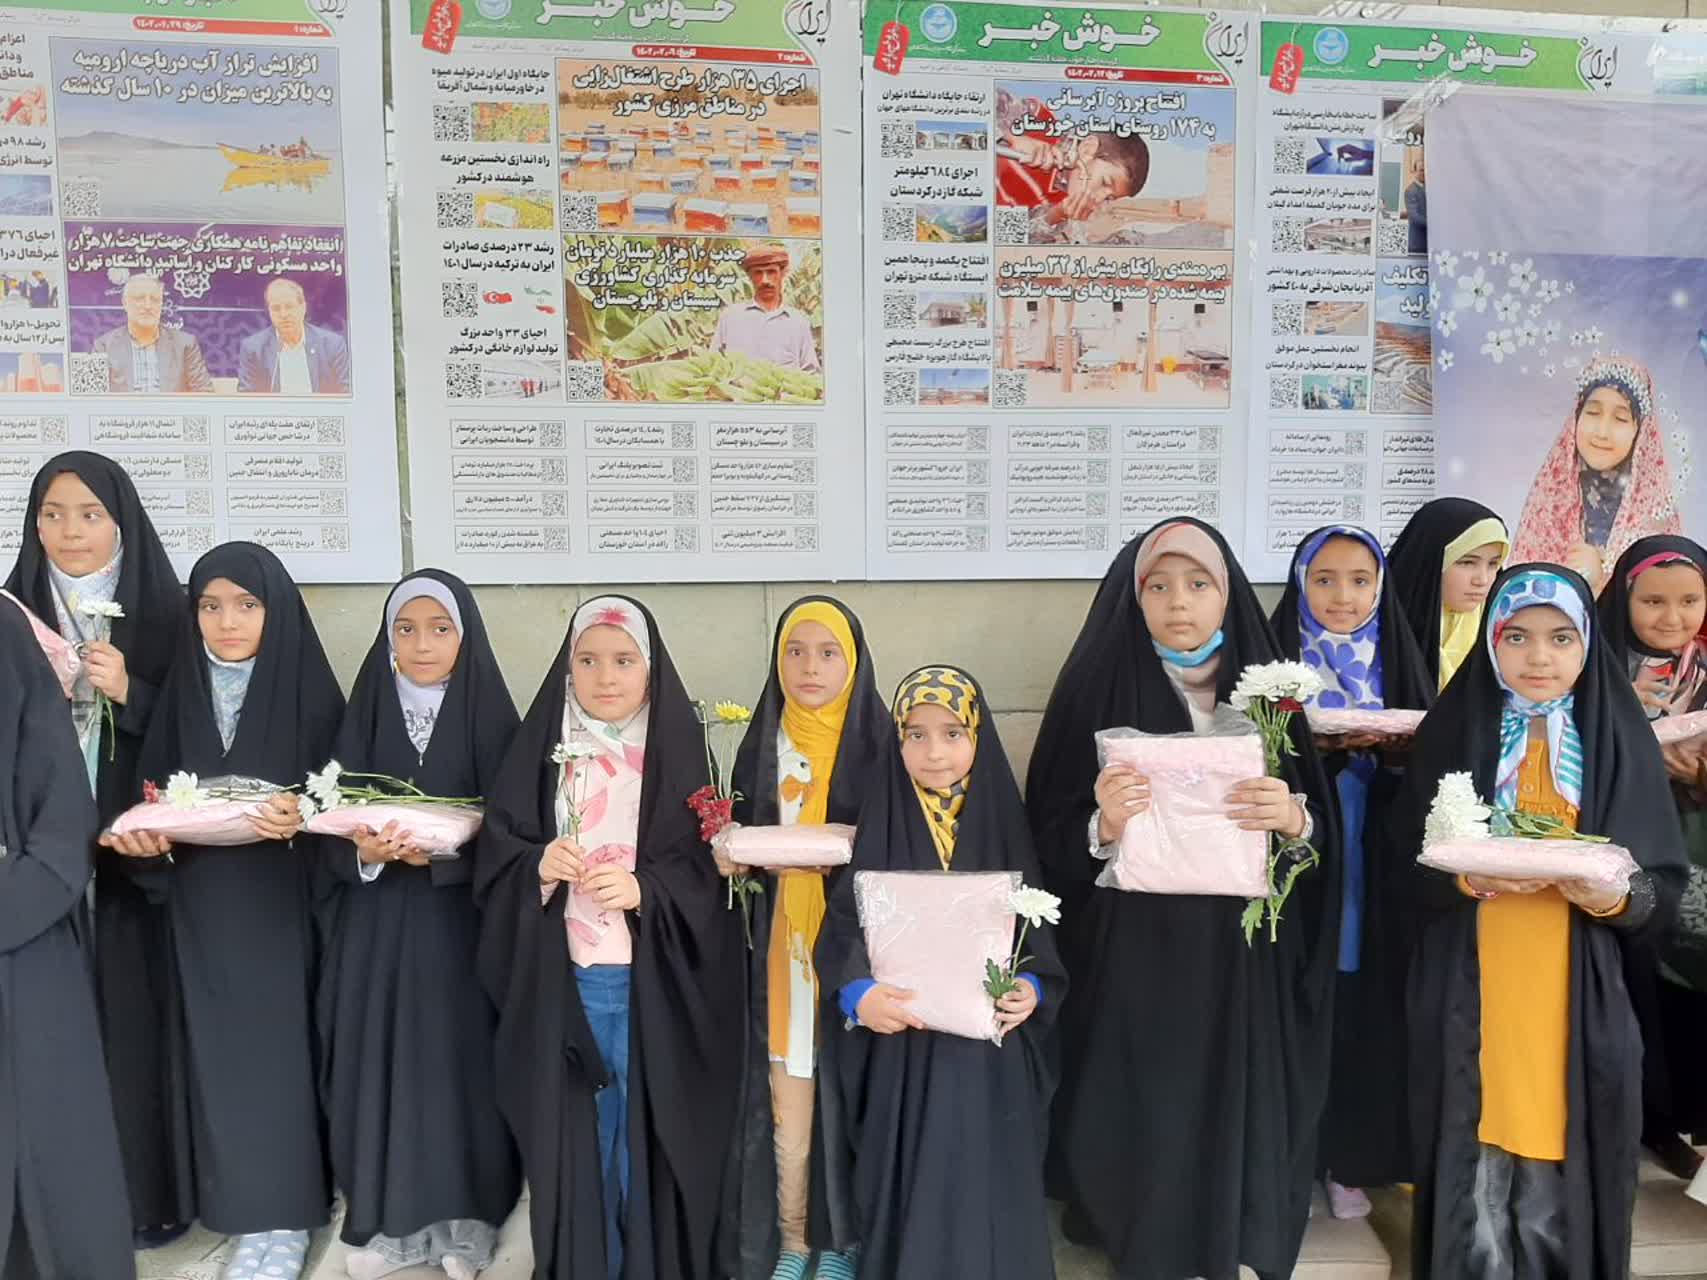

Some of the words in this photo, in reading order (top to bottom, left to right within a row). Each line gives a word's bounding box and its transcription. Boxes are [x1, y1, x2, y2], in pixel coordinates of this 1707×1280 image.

[977, 11, 1062, 50] خبر
[1062, 12, 1162, 52] خوش
[1368, 32, 1447, 70] خبر
[1446, 33, 1538, 74] خوش
[73, 49, 127, 73] ارومیه
[131, 51, 189, 74] دریاچه
[190, 49, 219, 70] آب
[223, 53, 254, 76] تراز
[258, 55, 318, 78] افزایش
[432, 67, 451, 78] میوه
[453, 65, 475, 78] تولید
[486, 68, 506, 80] ایران
[508, 69, 521, 80] اول
[523, 69, 550, 80] جایگاه
[659, 68, 696, 90] طرح
[733, 69, 757, 89] ۳۵
[60, 75, 114, 98] گذشته
[154, 78, 172, 98] ۱۰
[437, 80, 462, 92] آفریقا
[464, 82, 487, 93] شمال
[495, 82, 534, 95] خاورمیانه
[699, 70, 729, 91] هزار
[761, 73, 806, 96] اجرای
[117, 77, 150, 101] سال
[177, 83, 199, 102] در
[201, 79, 248, 102] میزان
[251, 80, 314, 106] بالاترین
[315, 88, 334, 105] به
[535, 86, 545, 95] در
[882, 89, 903, 100] تهران
[904, 89, 936, 100] دانشگاه
[938, 91, 961, 102] جایگاه
[613, 94, 653, 116] کشور
[656, 98, 697, 118] مرزی
[700, 95, 745, 118] مناطق
[1048, 88, 1104, 112] آبرسانی
[1107, 90, 1144, 114] پروژه
[1146, 91, 1184, 113] افتتاح
[748, 102, 766, 120] در
[1011, 115, 1074, 137] خوزستان
[1075, 118, 1115, 138] استان
[1117, 117, 1168, 140] روستای
[1170, 118, 1199, 138] ۱۷۴
[1201, 122, 1216, 141] به
[26, 136, 46, 149] رشد
[441, 154, 466, 165] مزرعه
[468, 154, 506, 166] نخستین
[456, 170, 482, 184] کشور
[482, 174, 493, 184] در
[495, 171, 534, 185] هوشمند
[894, 165, 929, 178] کیلومتر
[951, 167, 978, 179] اجرای
[890, 185, 931, 198] کردستان
[931, 190, 942, 199] در
[942, 187, 955, 199] گاز
[957, 186, 983, 200] شبکه
[72, 231, 100, 251] هزار
[102, 231, 112, 247] ۷
[116, 232, 155, 252] ساخت
[157, 232, 188, 250] جهت
[191, 232, 241, 253] همکاری
[304, 236, 340, 252] انعقاد
[443, 240, 479, 253] صادرات
[481, 243, 517, 255] درصدی
[534, 241, 554, 255] رشد
[565, 240, 606, 263] تومان
[608, 241, 656, 264] میلیارد
[656, 244, 688, 264] هزار
[692, 244, 706, 257] ۱۰
[710, 247, 747, 265] جذب
[68, 254, 103, 272] تهران
[105, 253, 152, 268] دانشگاه
[155, 254, 192, 271] اساتید
[193, 259, 203, 273] و
[257, 256, 308, 275] مسکونی
[310, 257, 343, 276] واحد
[461, 258, 482, 270] سال
[482, 262, 494, 271] در
[495, 259, 519, 272] ترکیه
[521, 263, 531, 272] به
[532, 259, 554, 272] ایران
[935, 256, 960, 266] یکصد
[962, 255, 989, 268] افتتاح
[1000, 257, 1045, 278] میلیون
[1048, 255, 1070, 274] ۳۲
[1072, 257, 1086, 278] از
[1088, 257, 1117, 278] بیش
[575, 266, 640, 287] کشاورزی
[642, 266, 688, 288] گذاری
[884, 271, 907, 283] تهران
[1119, 258, 1161, 280] رایگان
[691, 268, 737, 289] سرمایه
[909, 274, 927, 283] مترو
[929, 272, 952, 283] شبکه
[954, 271, 988, 284] ایستگاه
[998, 281, 1043, 298] سلامت
[1045, 284, 1072, 300] بیمه
[1169, 284, 1197, 299] شده
[1267, 280, 1291, 292] کشور
[1300, 283, 1308, 293] به
[1309, 281, 1332, 293] شرقی
[1333, 281, 1373, 294] آذربایجان
[592, 288, 658, 311] بلوچستان
[671, 290, 720, 311] سیستان
[1152, 287, 1167, 305] در
[1198, 287, 1226, 304] بیمه
[661, 297, 669, 311] و
[460, 327, 481, 339] بزرگ
[482, 328, 503, 339] واحد
[521, 328, 547, 340] احیای
[449, 343, 474, 354] کشور
[474, 346, 483, 355] در
[485, 343, 512, 355] خانگی
[513, 343, 535, 355] لوازم
[536, 344, 558, 355] تولید
